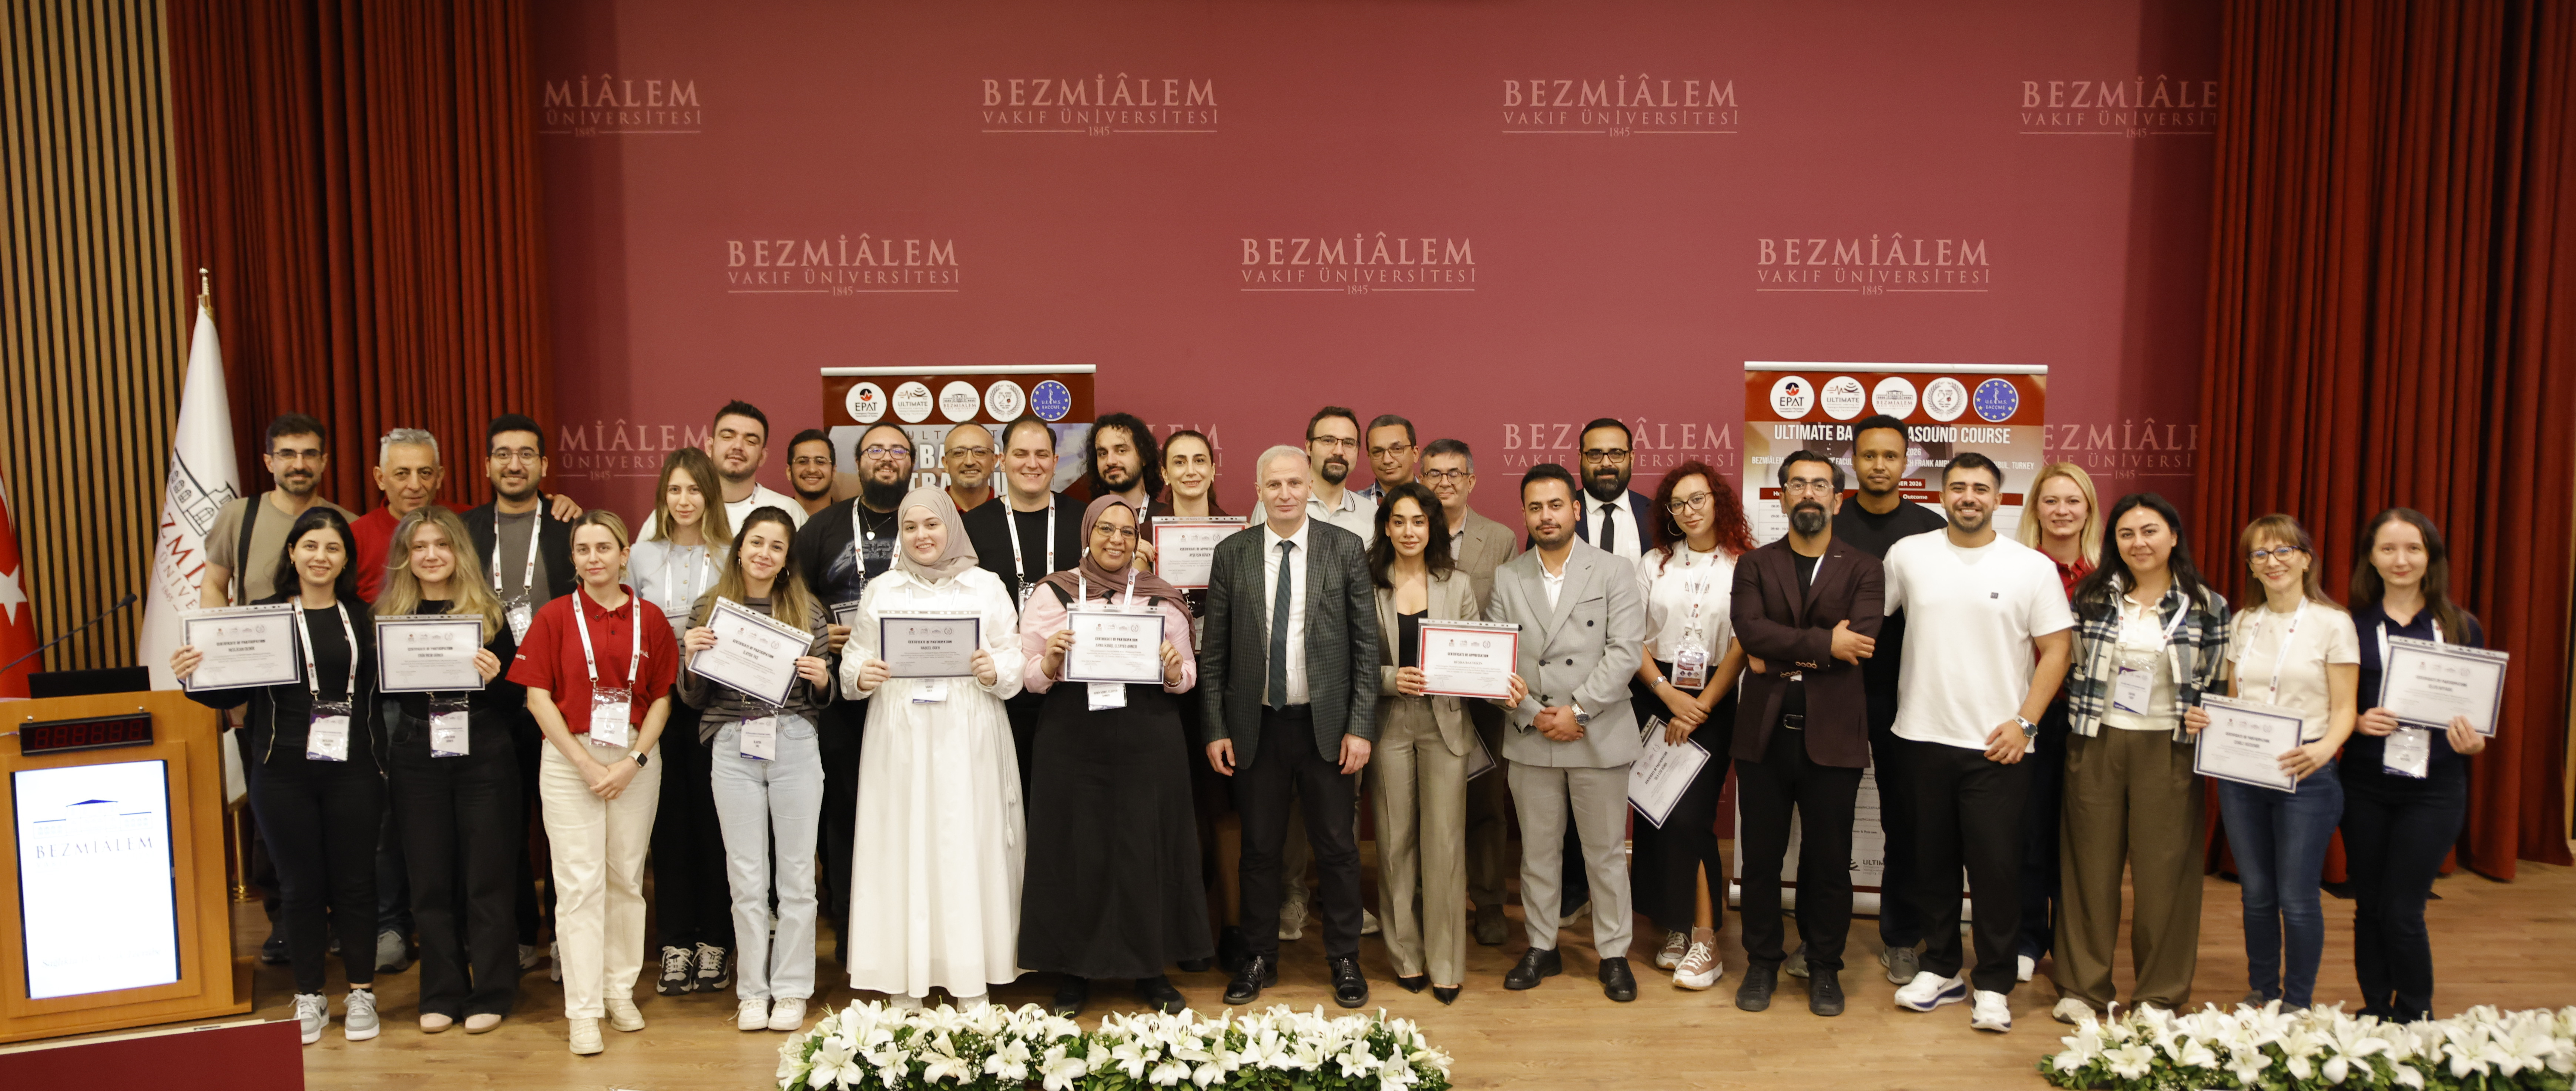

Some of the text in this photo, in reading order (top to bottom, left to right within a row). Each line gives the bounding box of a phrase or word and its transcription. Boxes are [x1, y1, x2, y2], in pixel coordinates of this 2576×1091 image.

[543, 73, 701, 107] MİÂLEM
[982, 72, 1218, 107] BEZMİÂLEM
[1502, 73, 1738, 107] BEZMİÂLEM
[2022, 74, 2217, 108] BEZMİÂLE
[982, 111, 1046, 124] VAKIF
[1503, 111, 1567, 125] VAKIF
[2021, 113, 2084, 125] VAKIF
[1089, 126, 1110, 136] 1845
[1610, 127, 1630, 137] 1845
[2126, 128, 2147, 138] 1845
[727, 232, 959, 267] BEZMİÂLEM
[1241, 231, 1475, 265] BEZMİÂLEM
[1758, 232, 1989, 266] BEZMİÂLEM
[728, 271, 791, 284] VAKIF
[1241, 269, 1305, 283] VAKIF
[1758, 270, 1821, 283] VAKIF
[833, 286, 853, 296] 1845
[1348, 285, 1368, 295] 1845
[1862, 285, 1883, 295] 1845
[855, 402, 878, 412] EPAT
[1780, 397, 1804, 406] EPAT
[1503, 416, 1734, 450] BEZÂLEM
[1774, 424, 1834, 441] ULTIMATE
[1907, 426, 1957, 443] ASOUND
[1960, 427, 2011, 444] COURSE
[1835, 457, 1852, 466] FACUL
[1914, 459, 1934, 467] FRANK
[2012, 461, 2034, 470] TURKEY
[2114, 469, 2136, 480] 1845
